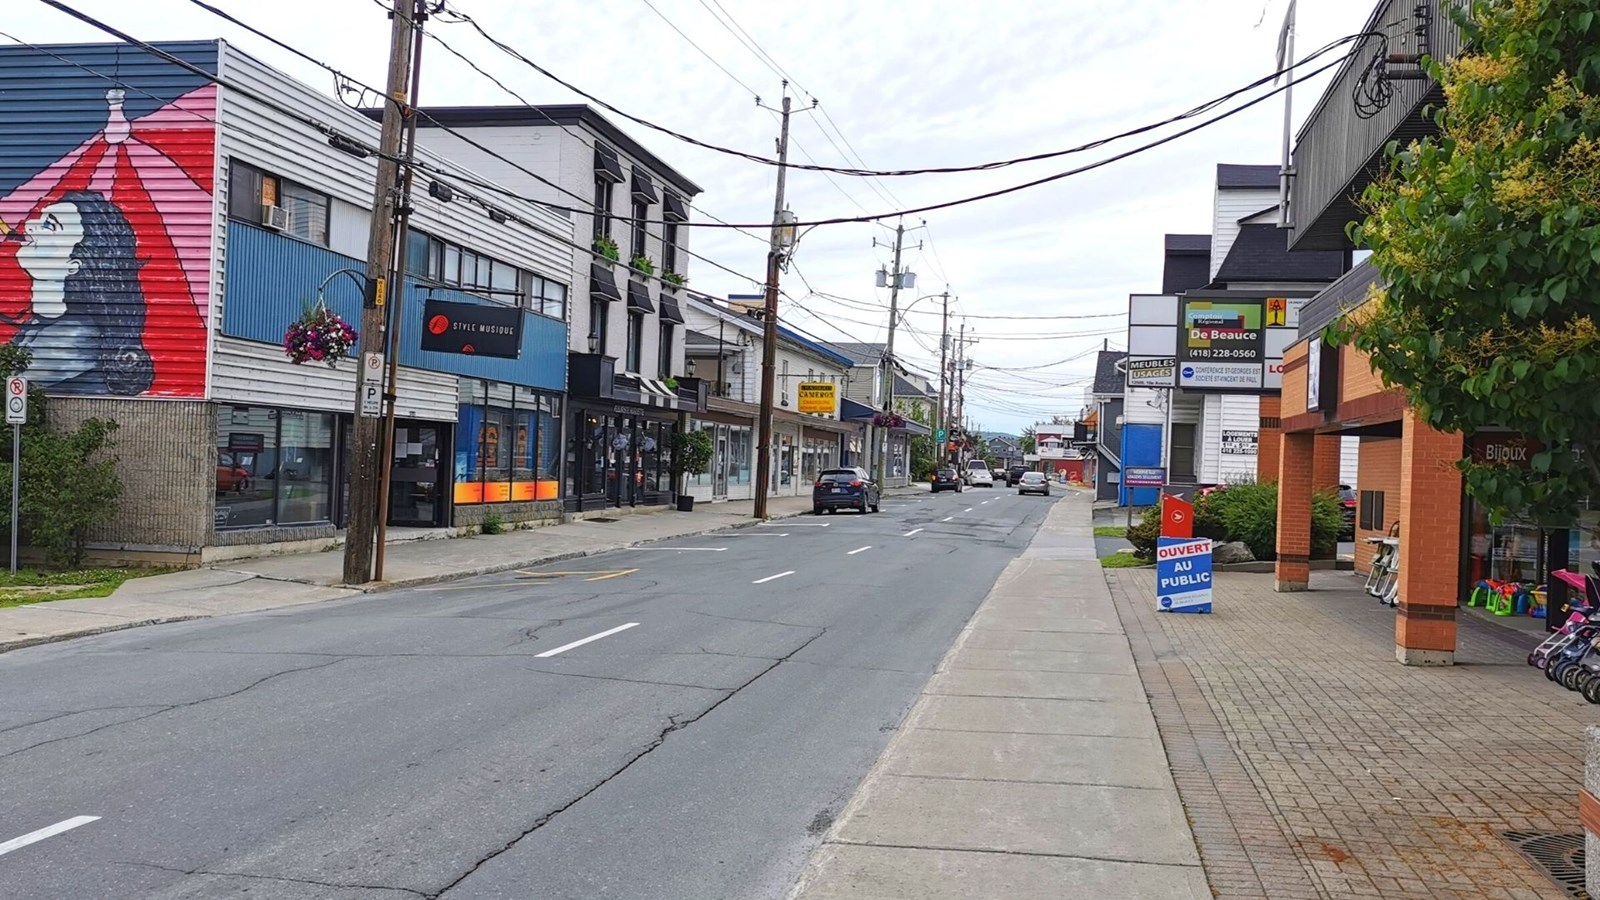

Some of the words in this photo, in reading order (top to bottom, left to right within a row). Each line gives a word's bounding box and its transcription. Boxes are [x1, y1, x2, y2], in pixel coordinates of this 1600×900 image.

[1188, 312, 1224, 320] Comptoir
[452, 322, 476, 332] STYLE
[480, 324, 514, 336] MUSIQUE
[1190, 330, 1208, 340] De
[1211, 330, 1258, 340] Beauce
[1190, 349, 1212, 358] (418)
[1212, 349, 1256, 358] 228-0560
[1130, 360, 1175, 369] MEUBLES
[1133, 368, 1171, 378] USAGÉS
[1195, 366, 1224, 374] CONFÉRENCE
[368, 388, 376, 399] P
[1486, 444, 1527, 462] Bijoux
[1159, 542, 1210, 558] OUVERT
[1174, 560, 1192, 572] AU
[1161, 572, 1210, 588] PUBLIC
